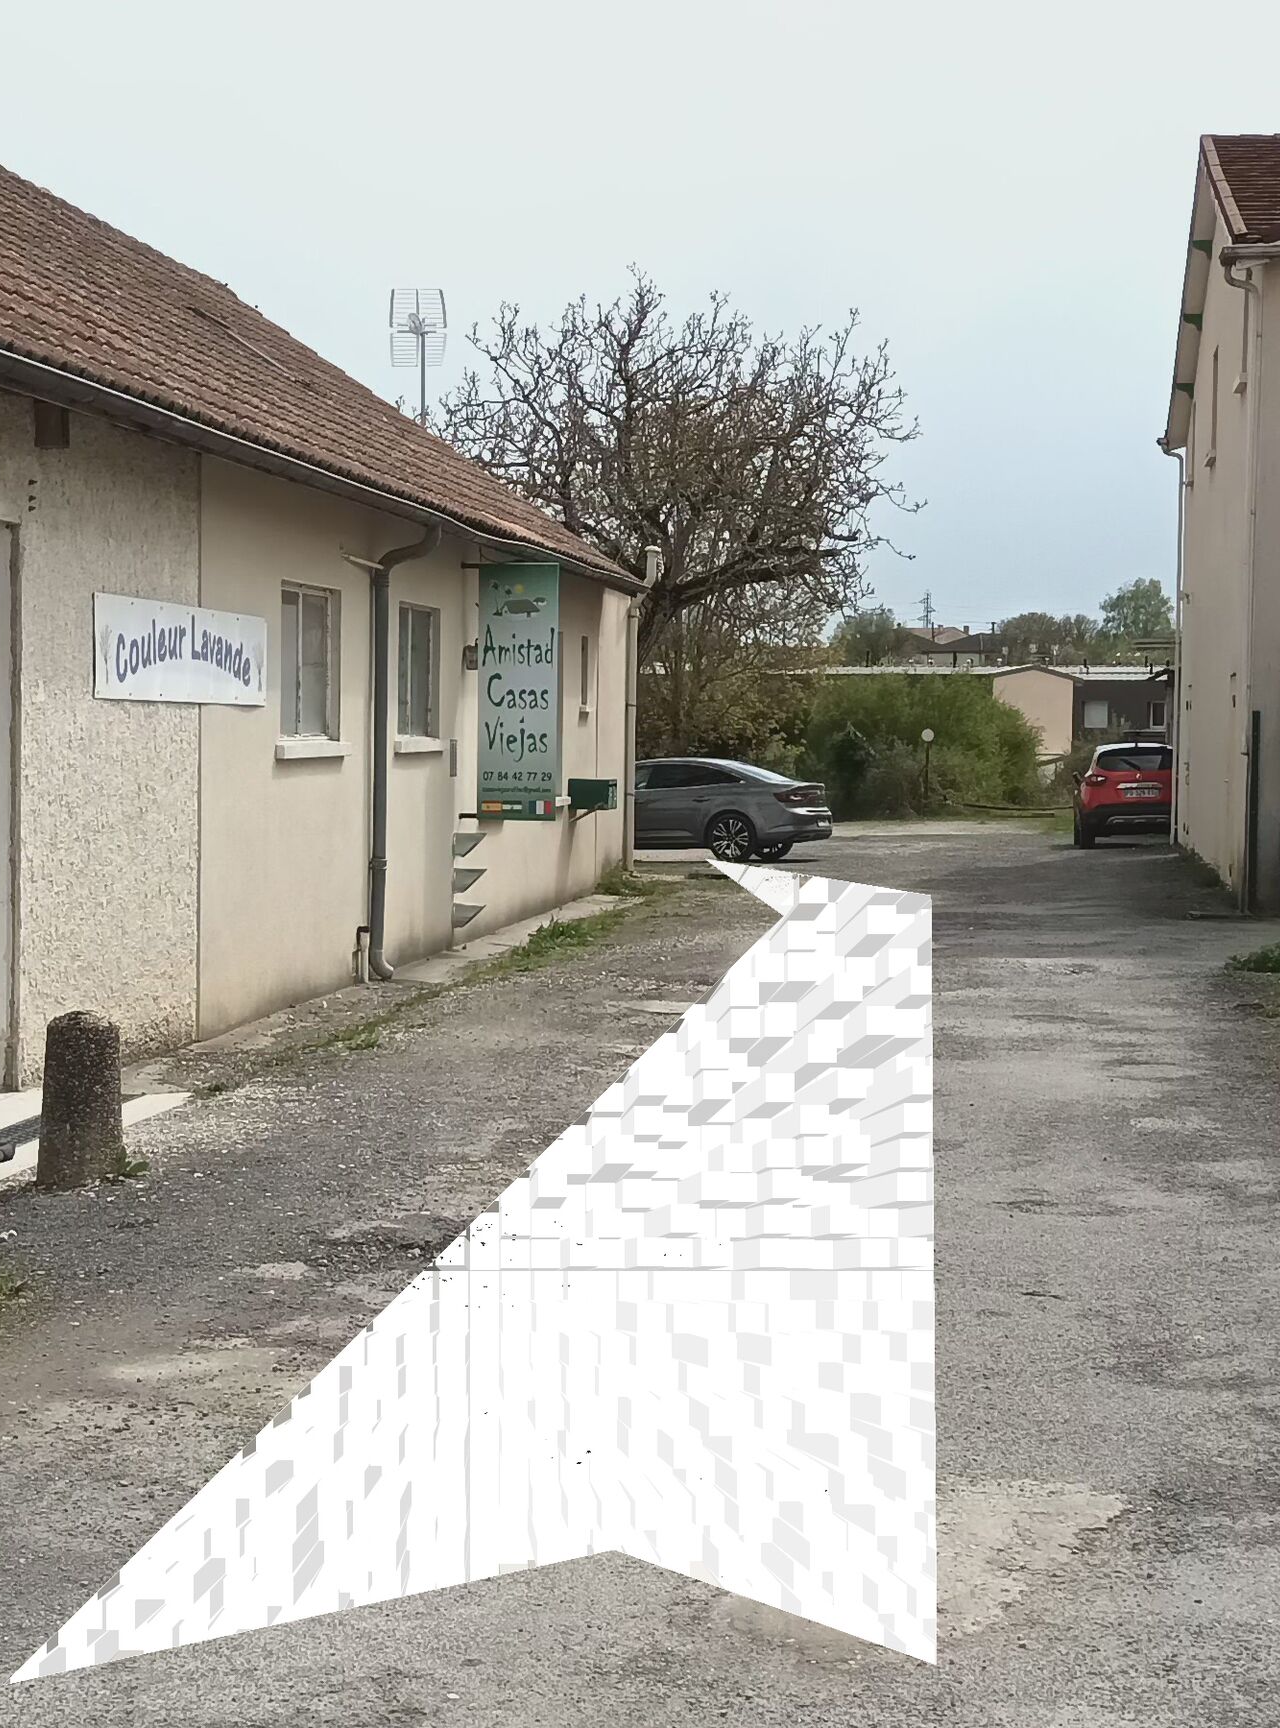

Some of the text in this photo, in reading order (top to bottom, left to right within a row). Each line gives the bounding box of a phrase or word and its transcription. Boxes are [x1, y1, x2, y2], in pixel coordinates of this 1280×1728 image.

[115, 614, 251, 687] Couleur Lavande
[482, 624, 556, 669] Amistad
[486, 673, 549, 711] Casas
[485, 716, 548, 763] Viejas
[482, 771, 552, 782] 07 84 42 77 29
